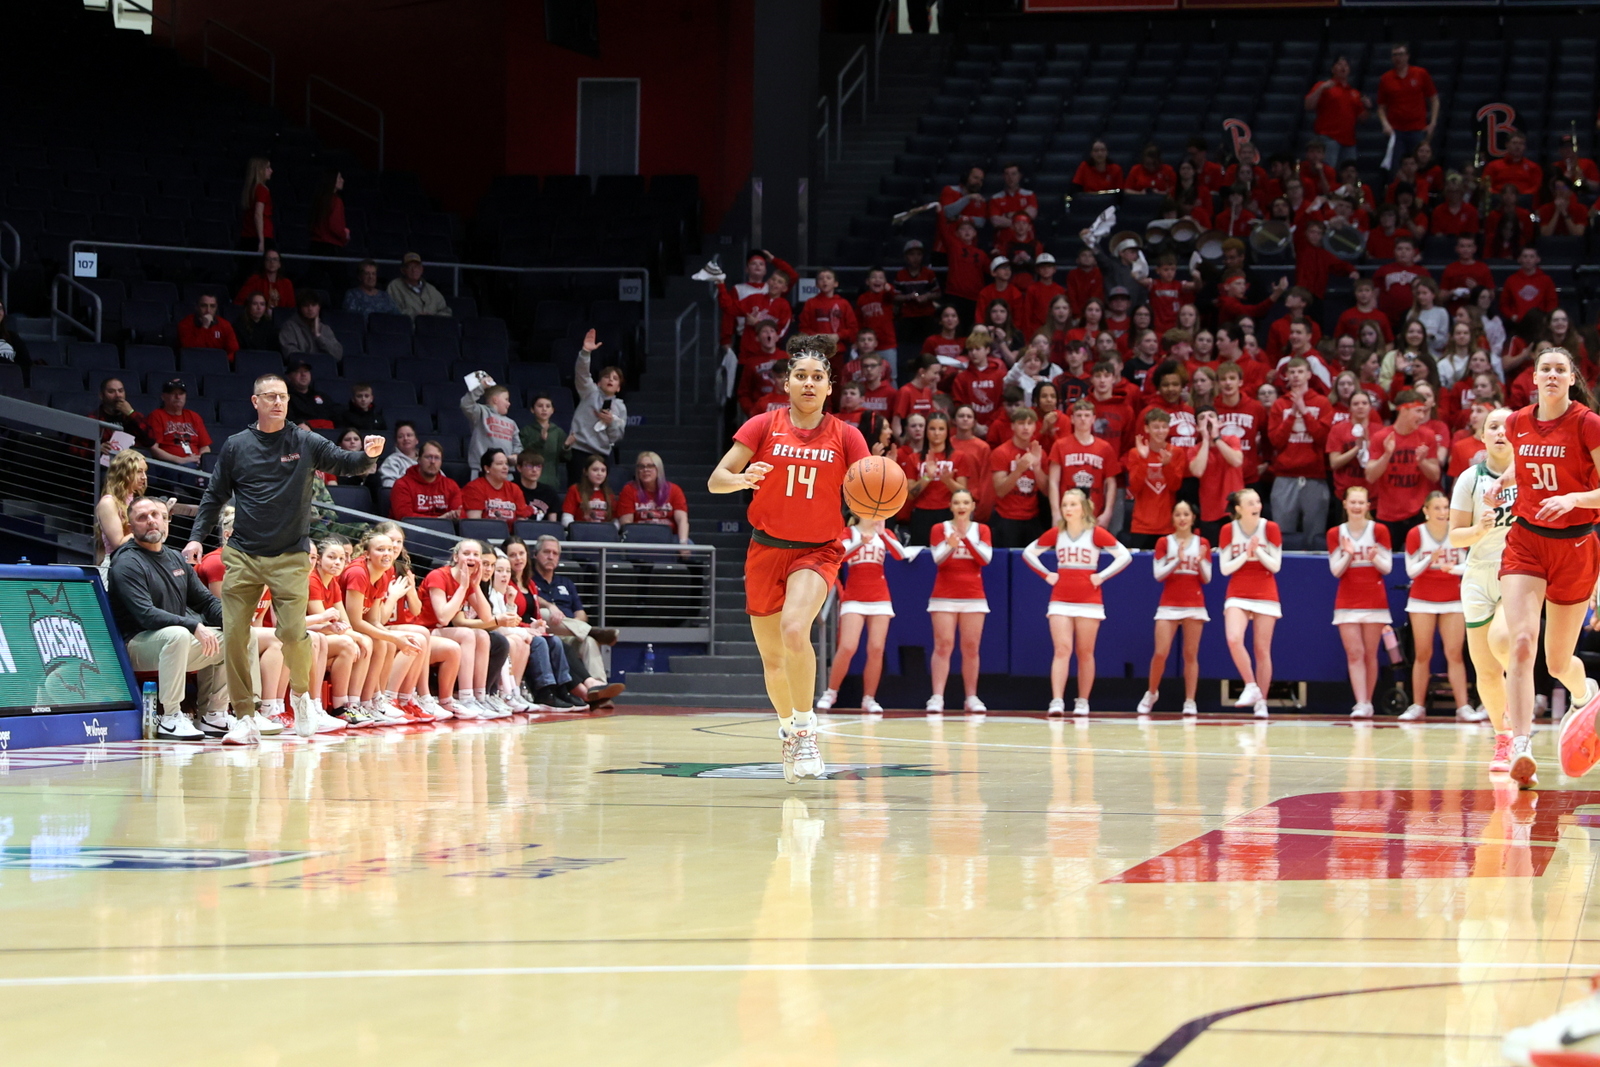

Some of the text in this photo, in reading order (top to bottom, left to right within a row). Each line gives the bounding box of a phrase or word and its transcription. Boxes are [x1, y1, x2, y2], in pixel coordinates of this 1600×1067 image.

[78, 260, 94, 269] 107
[622, 285, 639, 294] 107
[772, 443, 835, 463] BELLEVUE
[1519, 444, 1566, 458] BELLEVUE
[1064, 452, 1103, 470] BELLEVUE
[785, 464, 817, 499] 14
[1525, 463, 1558, 491] 30
[1493, 507, 1517, 527] 22
[721, 521, 739, 532] 108
[1057, 547, 1092, 565] BHS
[32, 616, 95, 665] OHSAA
